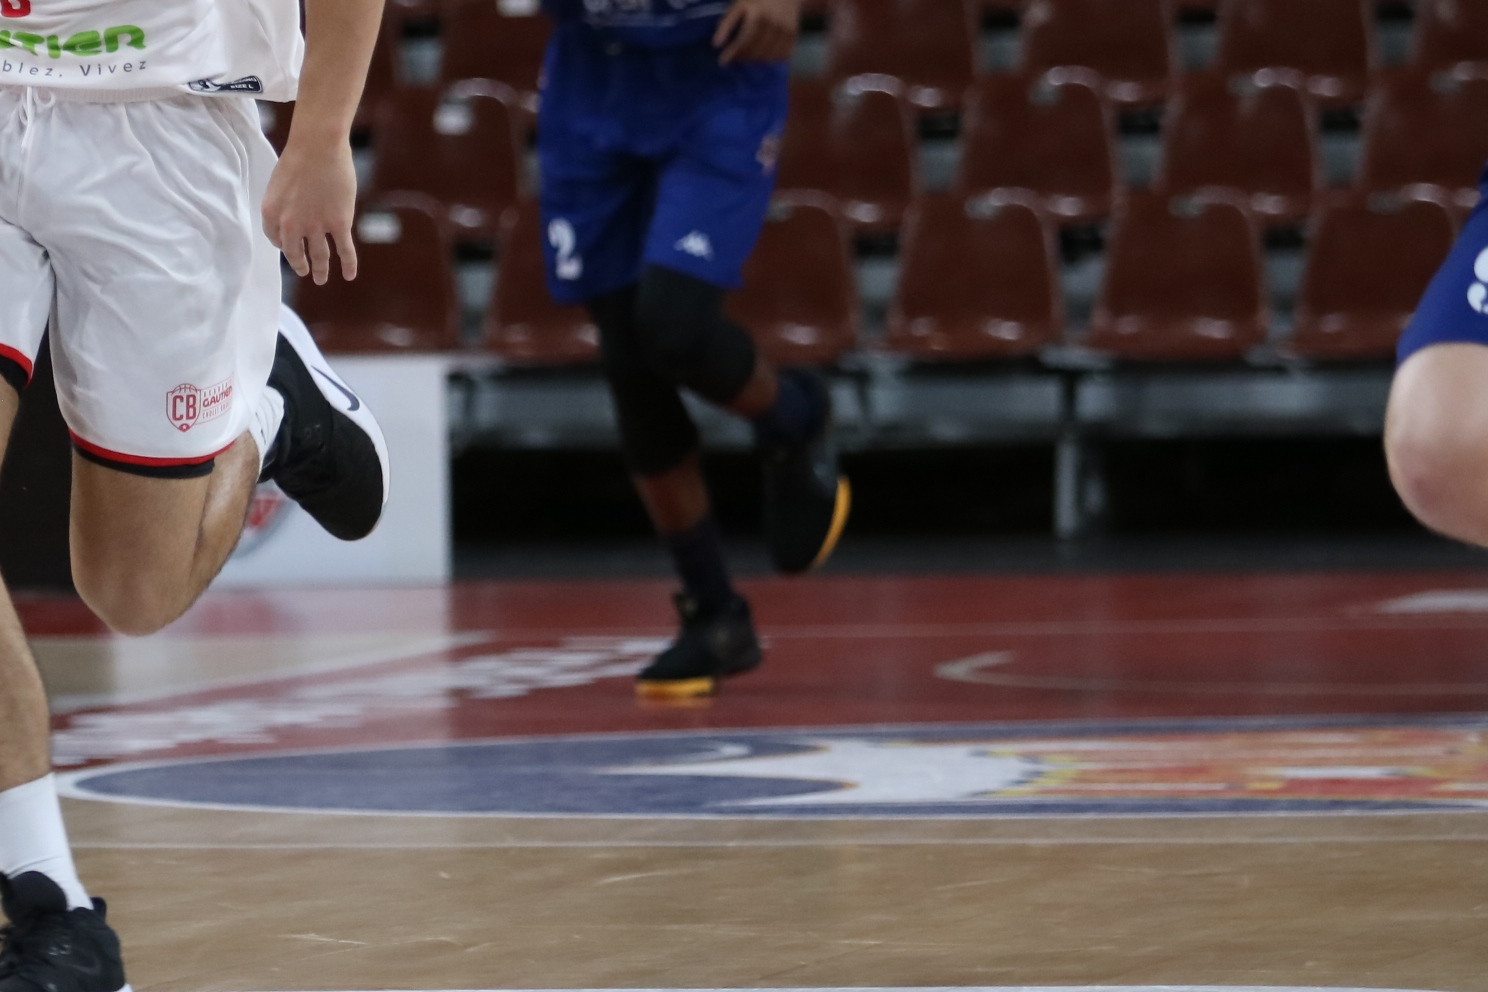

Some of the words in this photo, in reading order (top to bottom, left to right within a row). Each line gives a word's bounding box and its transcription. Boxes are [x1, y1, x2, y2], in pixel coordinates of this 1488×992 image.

[79, 59, 147, 78] Vivez
[548, 218, 583, 280] 2
[172, 394, 197, 421] CB
